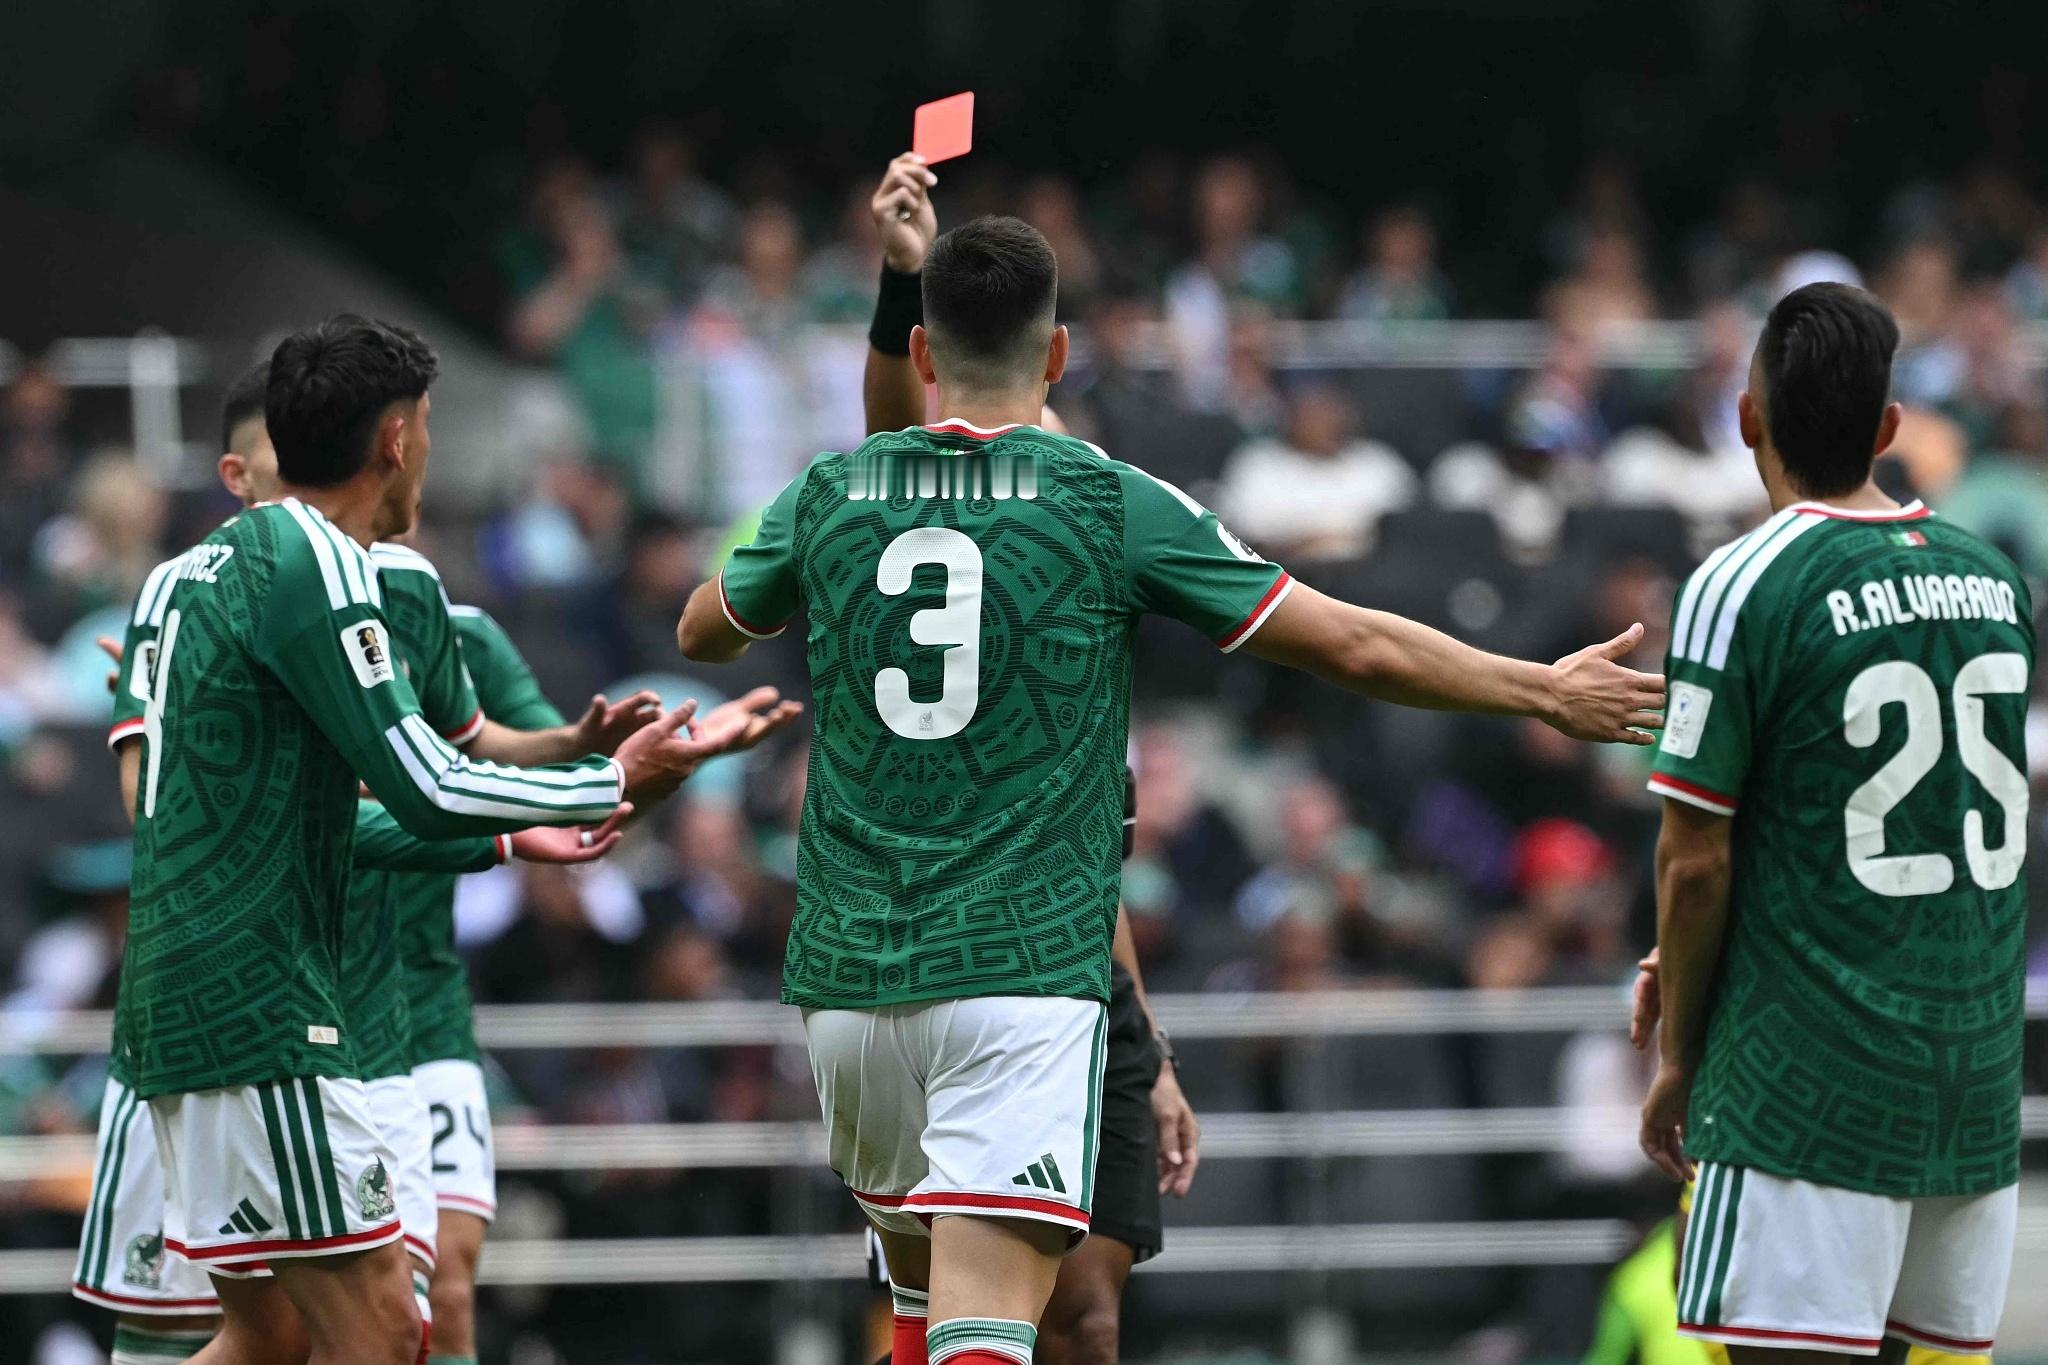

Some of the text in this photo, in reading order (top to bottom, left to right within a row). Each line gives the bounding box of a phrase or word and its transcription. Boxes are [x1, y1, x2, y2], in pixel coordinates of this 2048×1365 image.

[875, 527, 984, 740] 3
[1826, 574, 2018, 636] R.ALVARADO
[1843, 652, 2030, 897] 25
